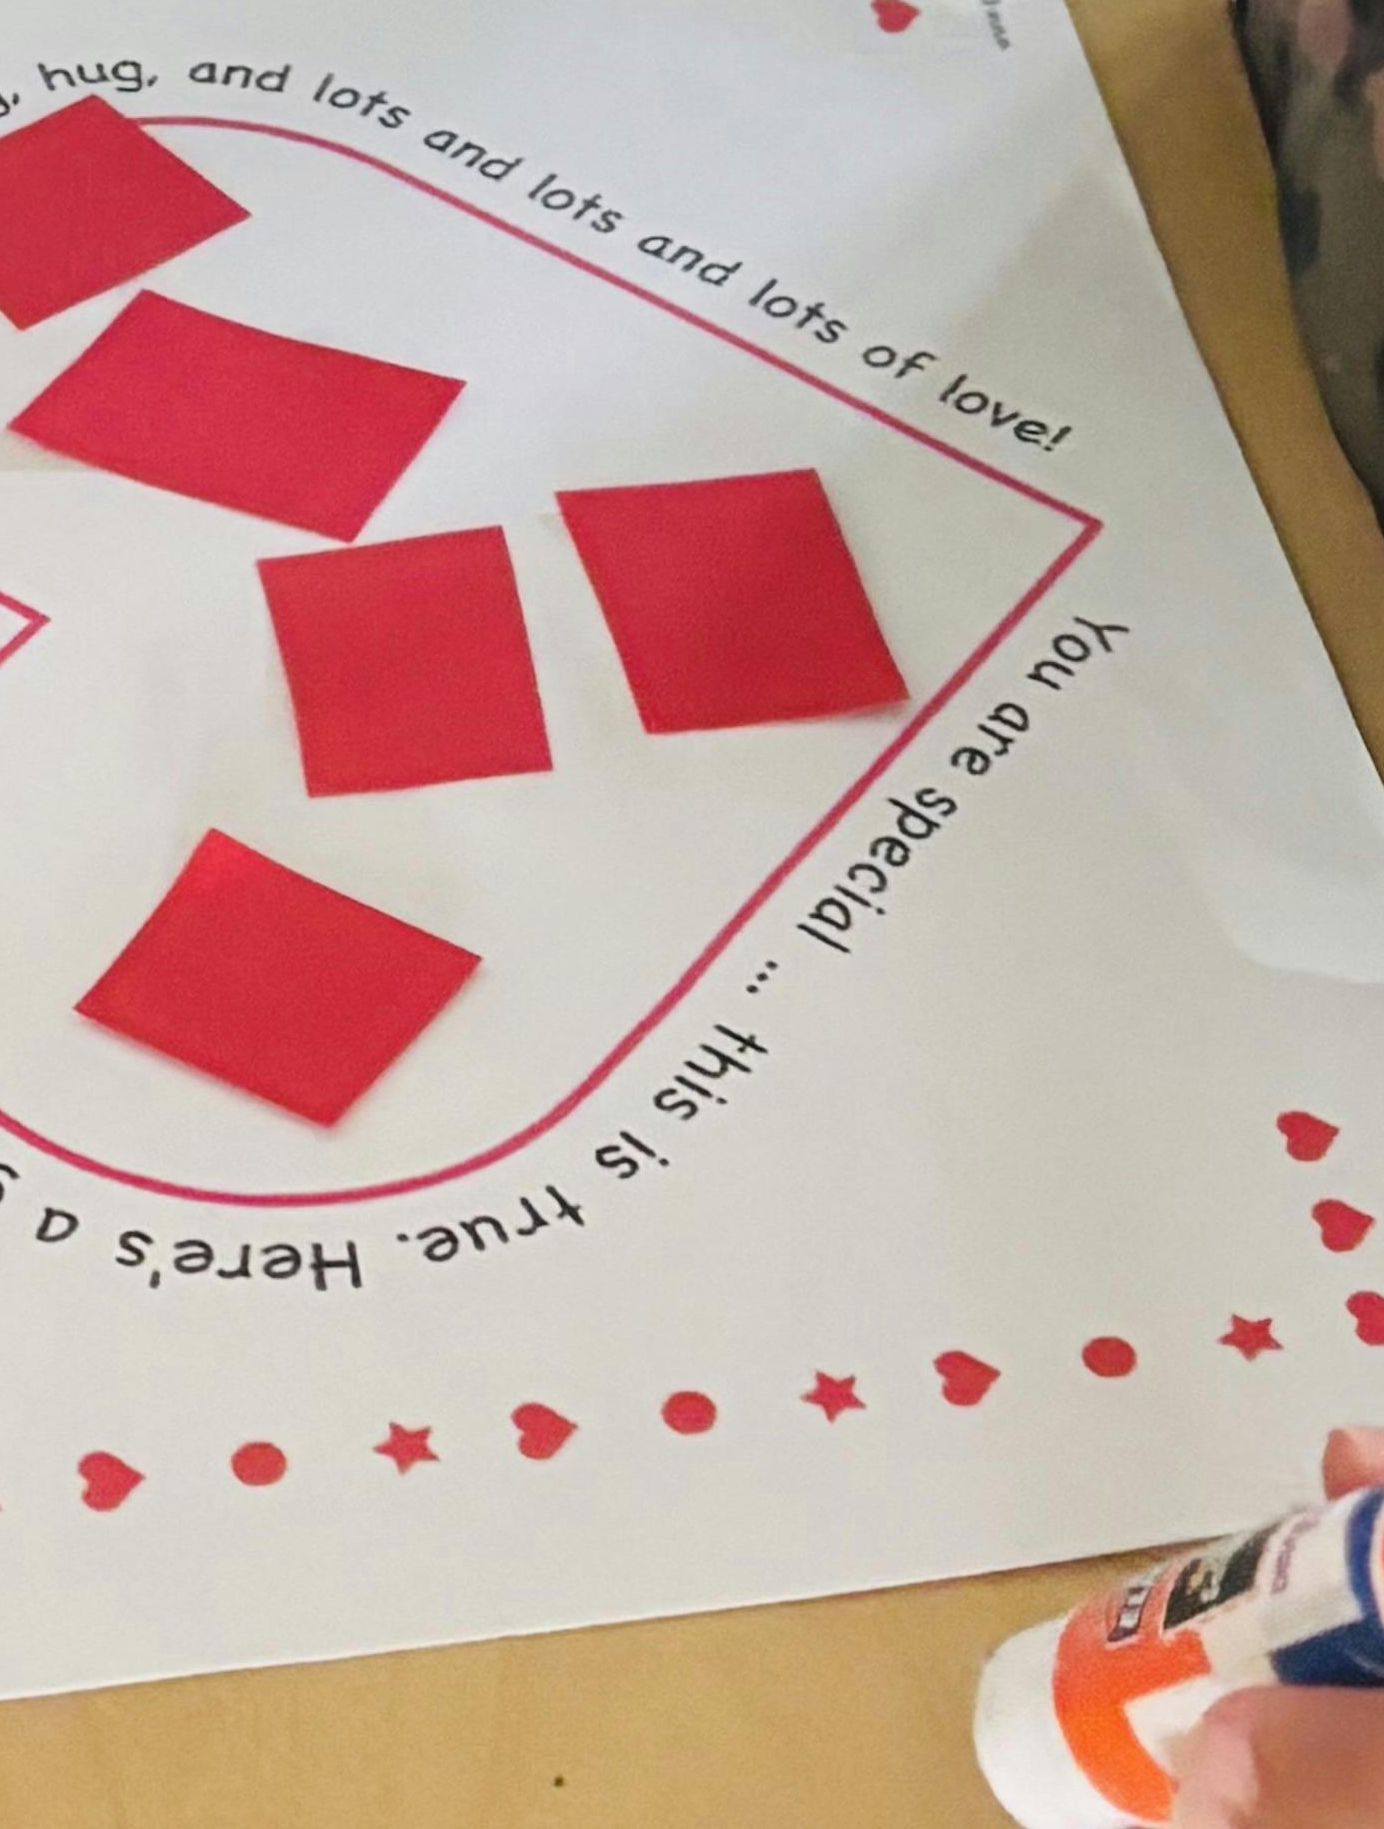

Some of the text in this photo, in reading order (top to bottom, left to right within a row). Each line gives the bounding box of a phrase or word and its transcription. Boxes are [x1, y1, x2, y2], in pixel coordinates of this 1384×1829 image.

[35, 57, 160, 102] hug,
[186, 60, 294, 95] and
[310, 71, 413, 131] lots
[421, 128, 525, 183] and
[526, 171, 625, 236] lots
[635, 234, 745, 289] and
[746, 276, 850, 346] lots
[859, 343, 940, 381] of
[936, 371, 1075, 455] love!
[1023, 614, 1132, 693] You
[947, 699, 1032, 778] are
[794, 785, 960, 956] special
[651, 1022, 771, 1123] this
[592, 1128, 672, 1182] is
[33, 1205, 81, 1245] a
[113, 1228, 365, 1294] Here's
[394, 1182, 587, 1265] true.
